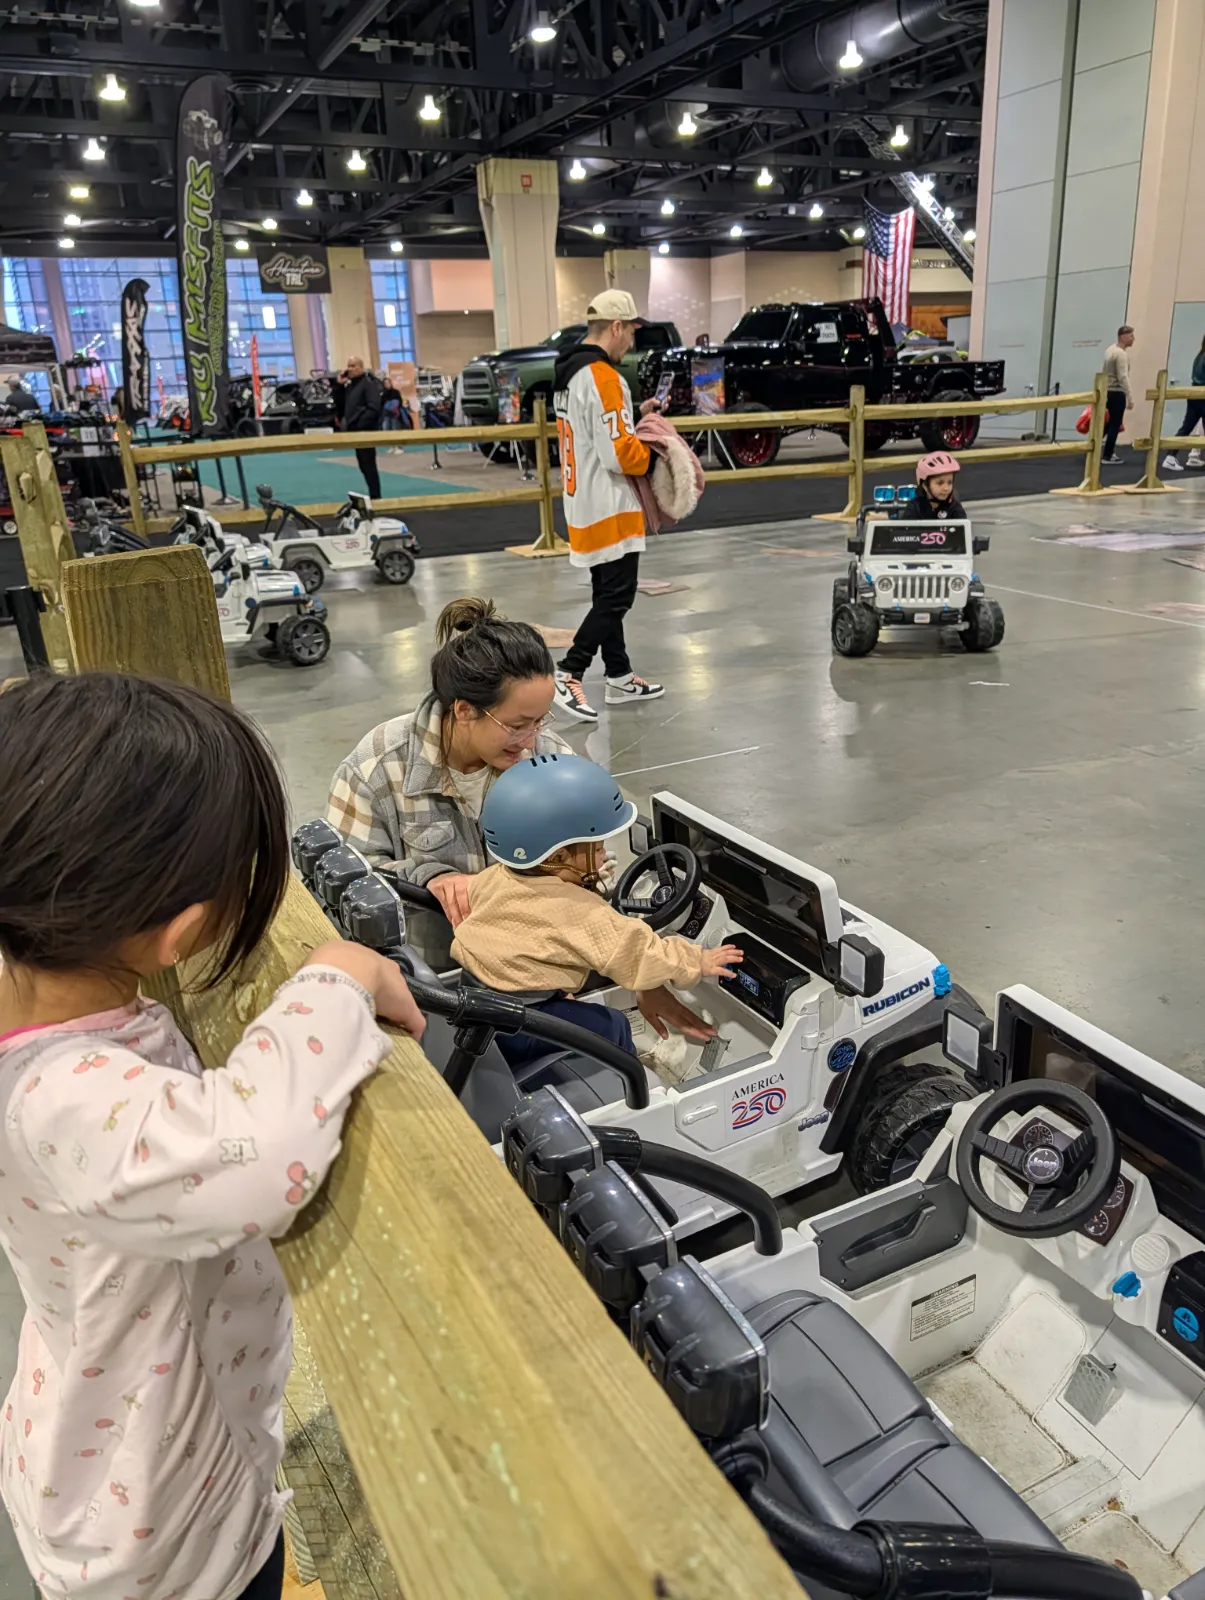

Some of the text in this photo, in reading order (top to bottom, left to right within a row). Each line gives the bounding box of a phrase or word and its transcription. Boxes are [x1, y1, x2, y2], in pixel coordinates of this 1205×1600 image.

[182, 156, 215, 346] MISFITS
[601, 408, 635, 440] 79
[920, 532, 947, 545] 250
[862, 977, 931, 1017] RUBICON
[732, 1073, 785, 1101] AMERICA
[732, 1087, 787, 1130] 250
[797, 1110, 830, 1132] Jeep
[1029, 1156, 1058, 1171] Jeep
